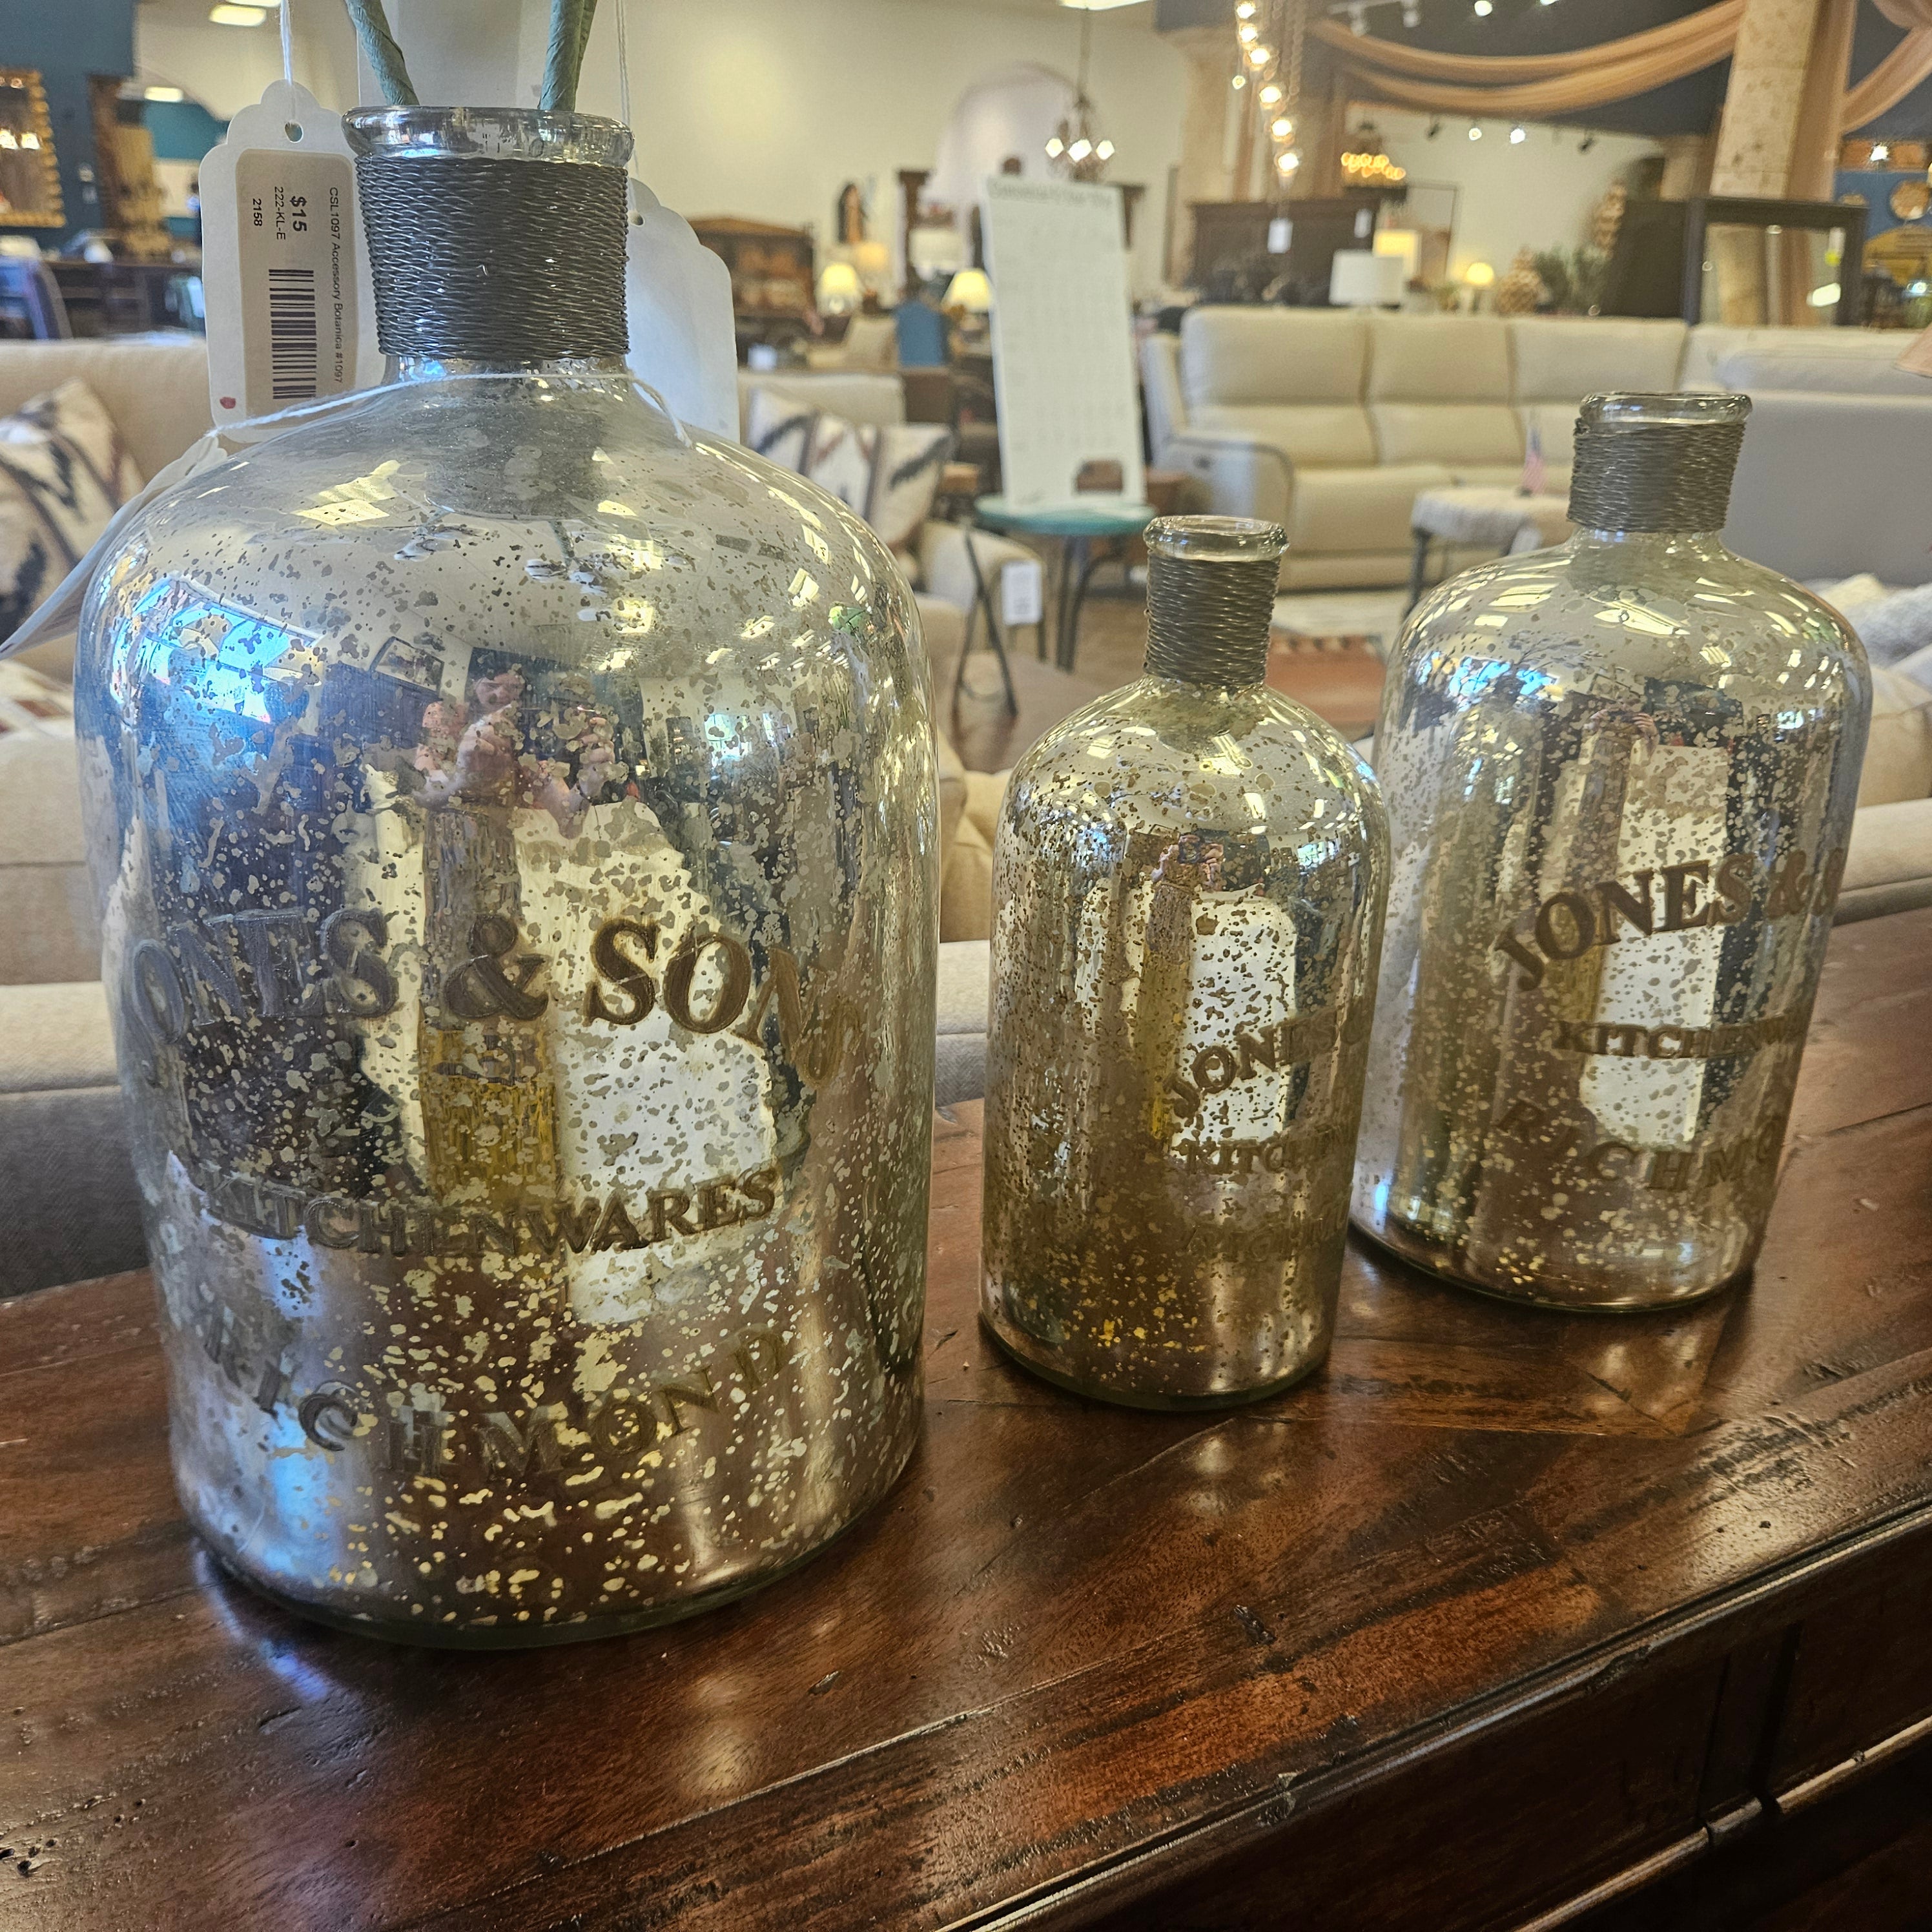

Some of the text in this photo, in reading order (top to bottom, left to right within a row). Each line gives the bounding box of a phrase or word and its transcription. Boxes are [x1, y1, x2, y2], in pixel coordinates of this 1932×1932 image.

[252, 197, 263, 227] 2158
[274, 186, 286, 240] 222-KL-E
[289, 194, 308, 232] $15
[329, 187, 344, 384] CSL1097 Accessory Botanica #1097
[1494, 852, 1755, 992] JONES
[444, 912, 550, 1022] &
